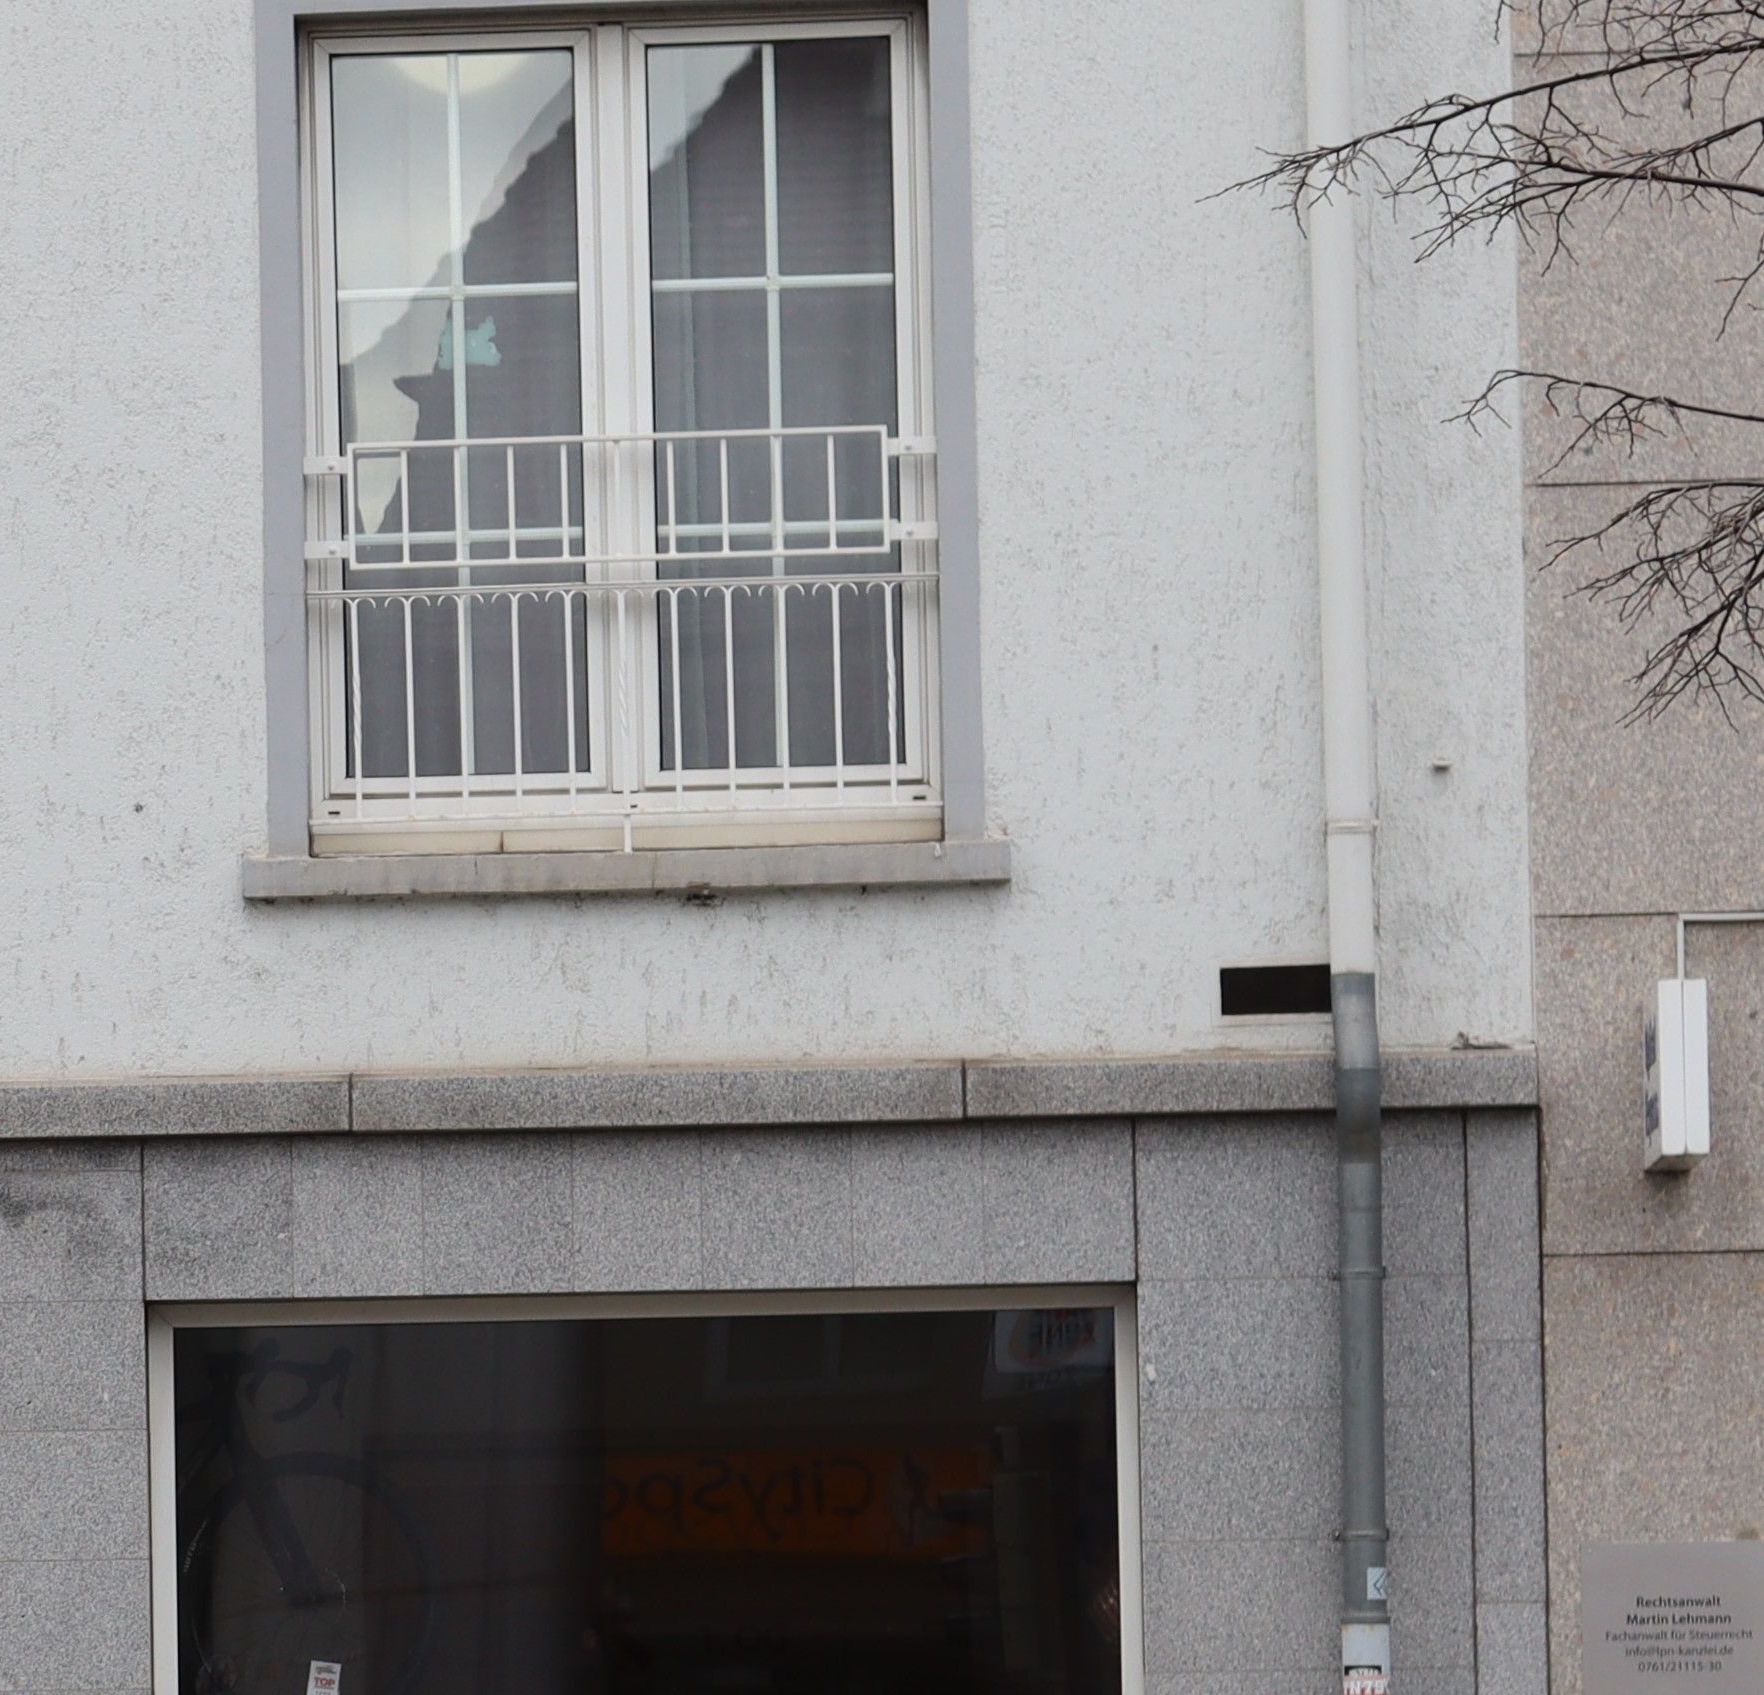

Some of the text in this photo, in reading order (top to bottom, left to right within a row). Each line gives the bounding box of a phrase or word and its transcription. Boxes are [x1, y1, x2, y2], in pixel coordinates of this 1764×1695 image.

[1636, 1595, 1721, 1608] Rechtsanwalt
[1626, 1613, 1731, 1625] Martin Lehmann
[1605, 1629, 1753, 1641] Fachanwalt für Steuerrecht
